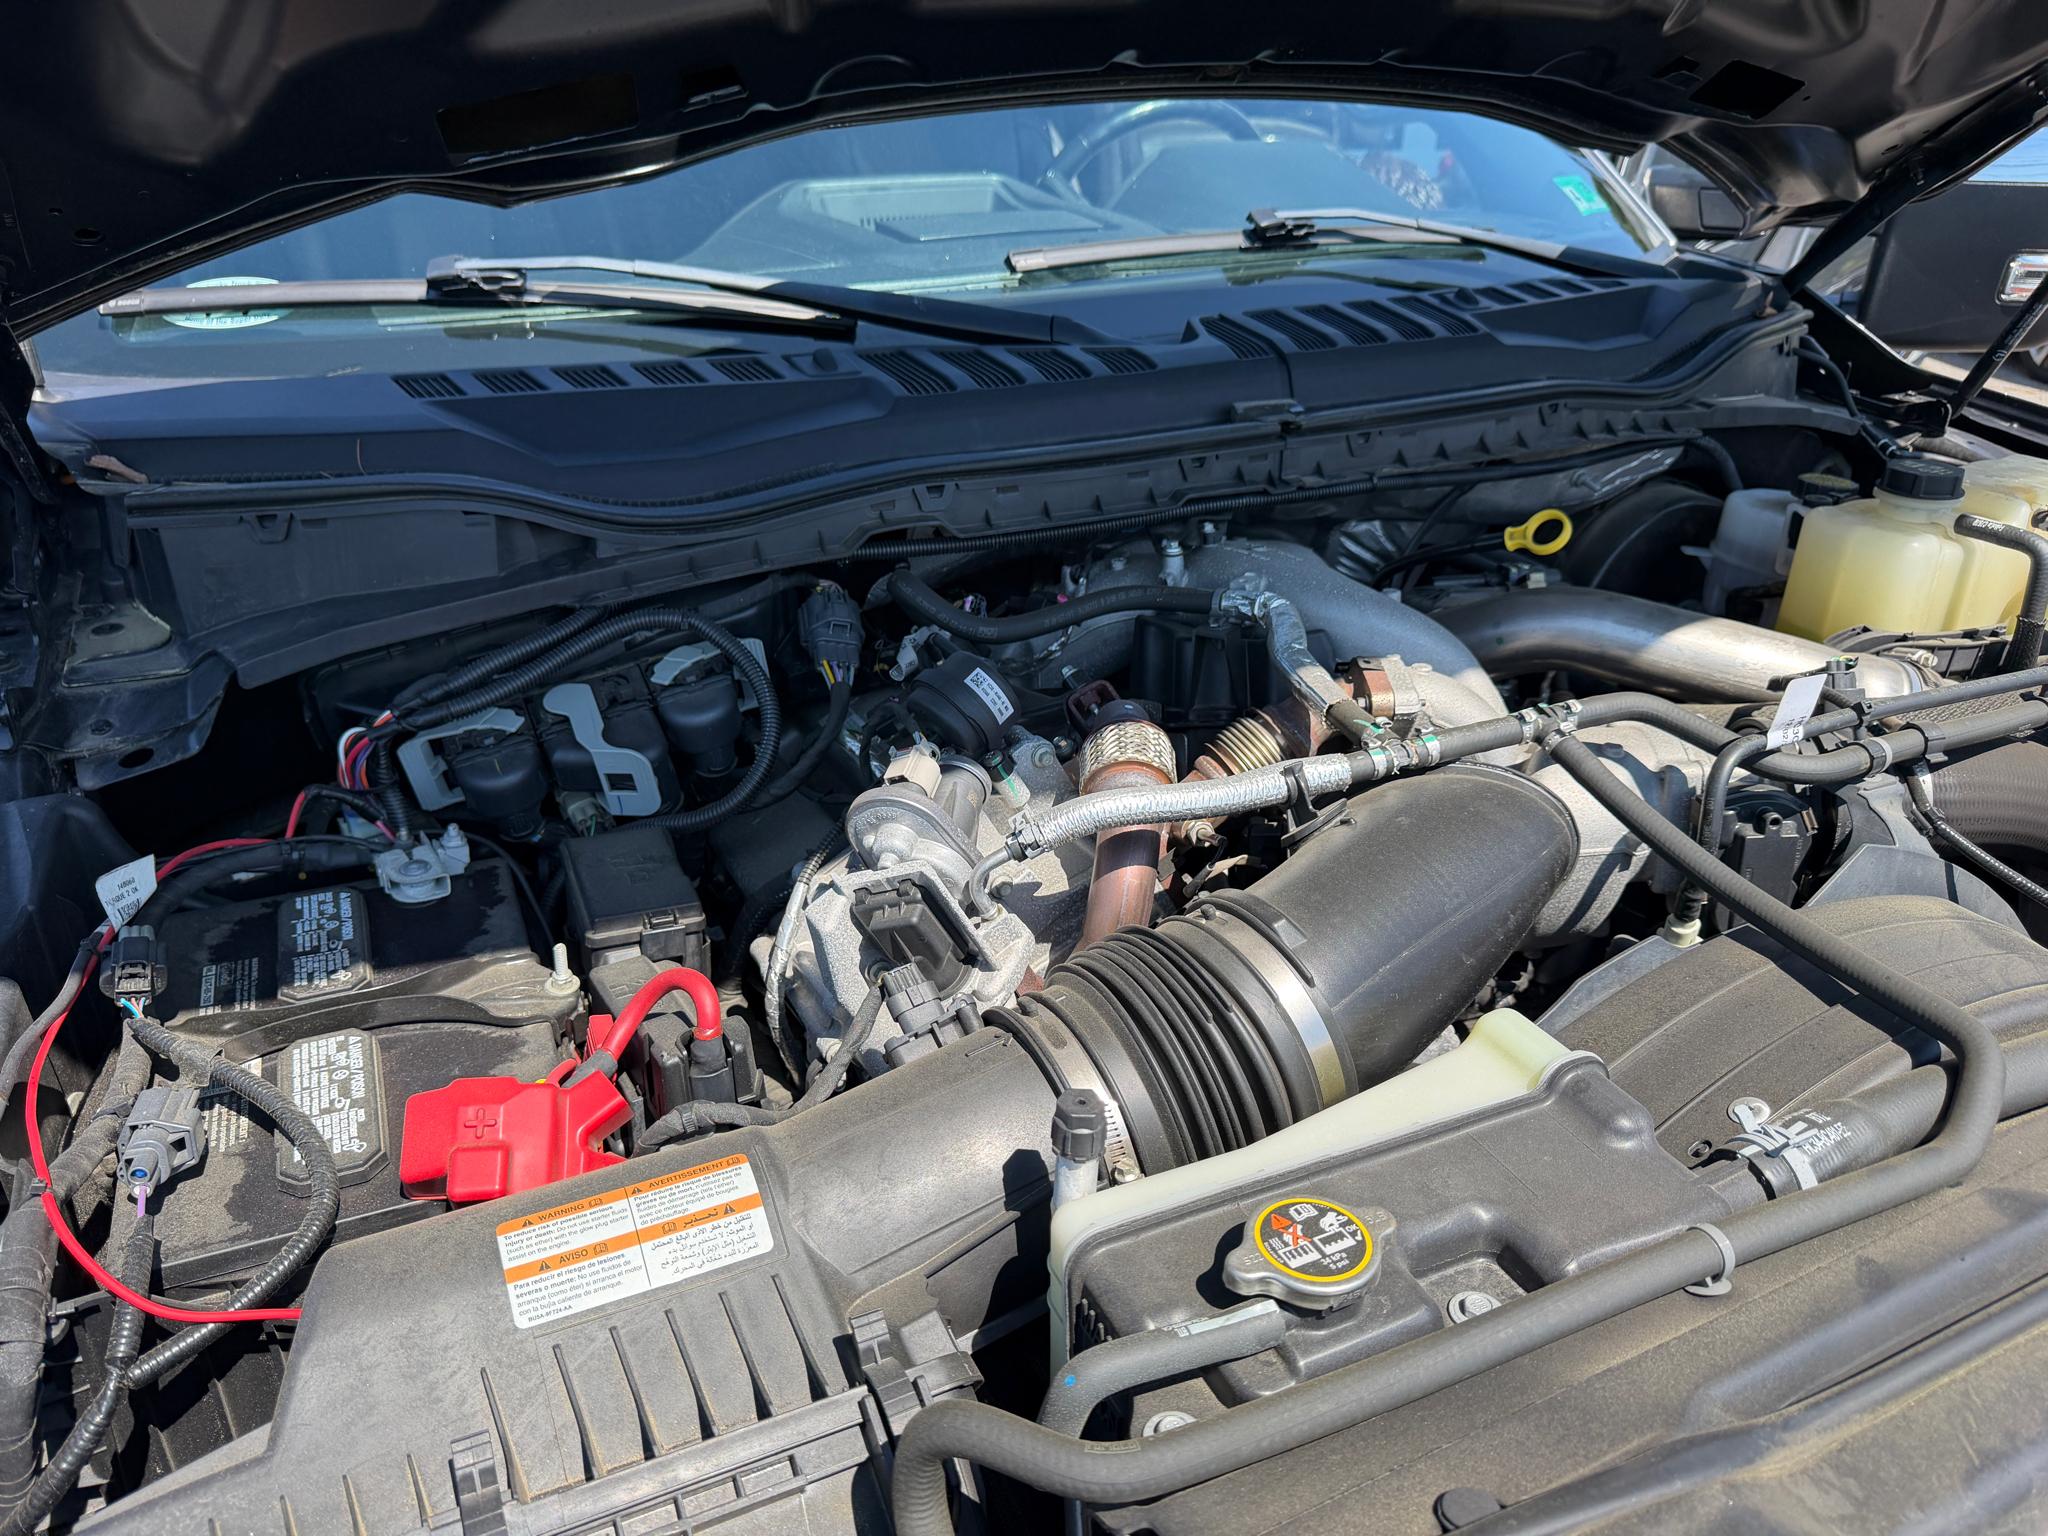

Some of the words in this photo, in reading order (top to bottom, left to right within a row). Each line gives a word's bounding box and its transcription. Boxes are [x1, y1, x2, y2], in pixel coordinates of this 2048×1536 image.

[633, 1193, 650, 1202] Pour
[650, 1186, 674, 1197] réduire
[681, 1178, 702, 1188] risque
[711, 1165, 742, 1178] blessures
[648, 1162, 723, 1188] AVERTISSEMENT
[635, 1197, 658, 1208] graves
[721, 1174, 733, 1182] pas
[637, 1203, 658, 1213] fluides
[666, 1190, 700, 1205] démarrage
[700, 1186, 714, 1194] (tels
[639, 1211, 654, 1220] avec
[663, 1202, 685, 1212] moteur
[715, 1185, 739, 1197] bougies
[505, 1238, 525, 1249] injury
[534, 1228, 555, 1239] death:
[578, 1218, 590, 1226] use
[591, 1212, 610, 1222] starter
[611, 1207, 628, 1216] fluids
[513, 1227, 536, 1238] reduce
[537, 1223, 550, 1231] risk
[560, 1212, 588, 1225] possible
[589, 1205, 613, 1216] serious
[538, 1203, 585, 1222] WARNING
[1345, 1223, 1360, 1232] OK
[506, 1245, 525, 1255] (such
[525, 1242, 534, 1250] as
[534, 1236, 553, 1247] ether)
[554, 1232, 568, 1241] with
[568, 1229, 578, 1237] the
[578, 1224, 594, 1234] glow
[595, 1220, 609, 1229] plug
[609, 1213, 629, 1224] starter
[507, 1252, 527, 1262] assist
[537, 1245, 548, 1253] the
[558, 1248, 589, 1264] AVISO
[1320, 1257, 1331, 1265] 34
[1330, 1252, 1348, 1261] kPa
[1337, 1259, 1350, 1268] psi
[514, 1280, 530, 1291] Para
[531, 1273, 555, 1286] reducir
[556, 1270, 563, 1278] el
[564, 1263, 586, 1276] riesgo
[587, 1260, 596, 1268] de
[596, 1251, 625, 1265] lesiones
[515, 1286, 543, 1300] severas
[577, 1272, 588, 1281] No
[588, 1268, 601, 1277] use
[601, 1262, 622, 1273] fluidos
[622, 1259, 631, 1267] de
[517, 1294, 547, 1309] arranque
[547, 1287, 569, 1300] (como
[592, 1273, 617, 1285] arranca
[624, 1264, 643, 1275] motor
[518, 1307, 532, 1317] con
[532, 1305, 539, 1313] la
[557, 1291, 582, 1305] caliente
[583, 1288, 592, 1297] de
